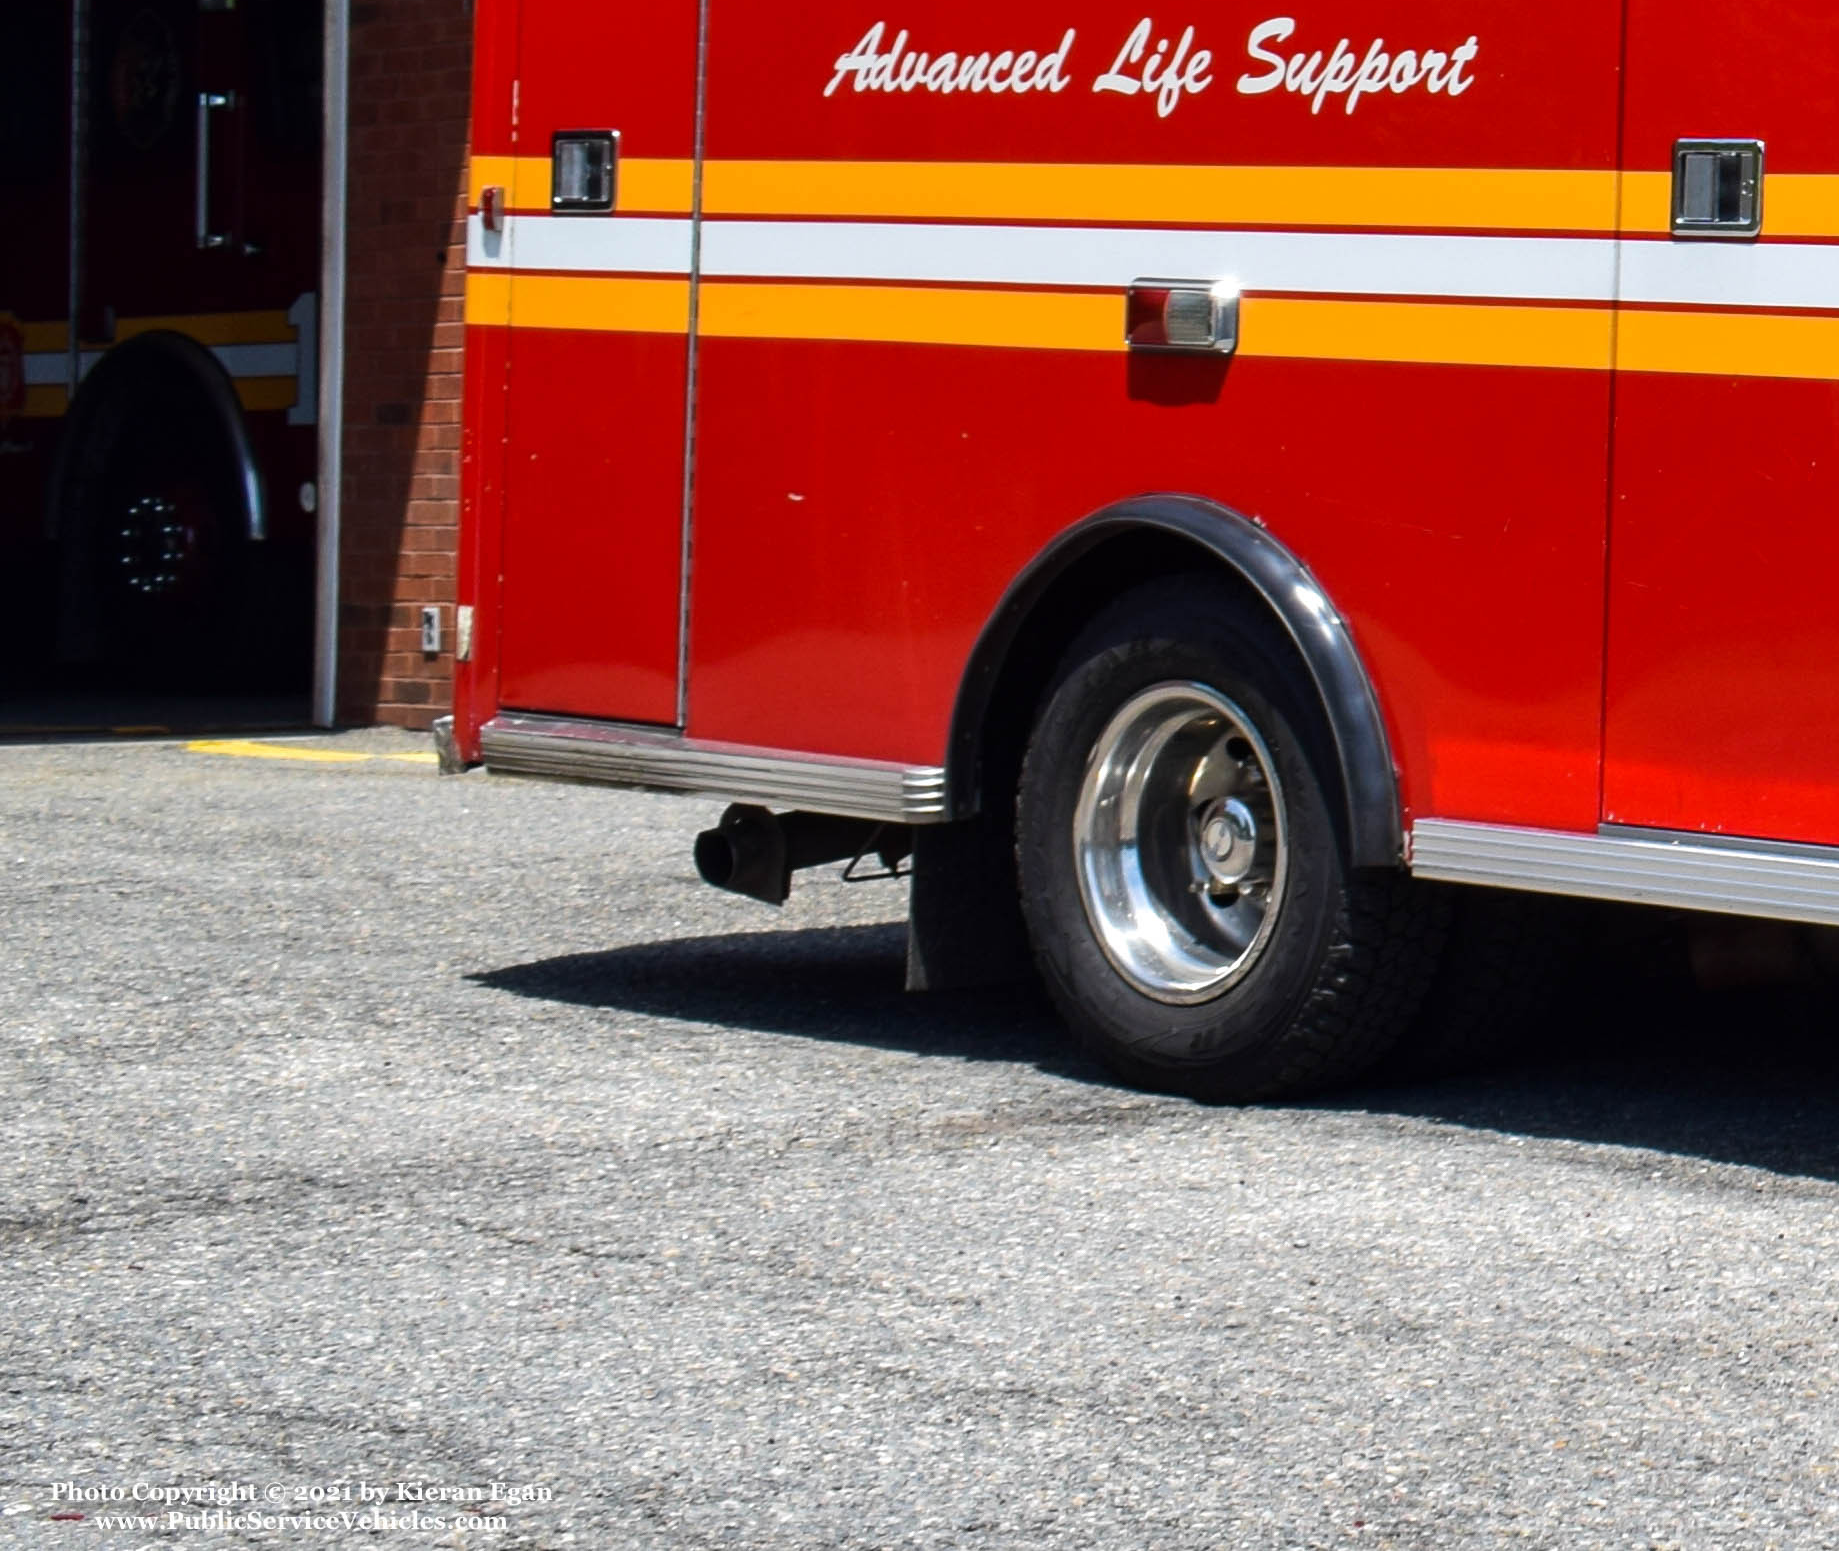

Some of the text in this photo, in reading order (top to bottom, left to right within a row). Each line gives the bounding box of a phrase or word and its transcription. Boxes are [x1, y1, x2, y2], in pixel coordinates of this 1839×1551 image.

[823, 16, 1479, 118] Advanced Life Support
